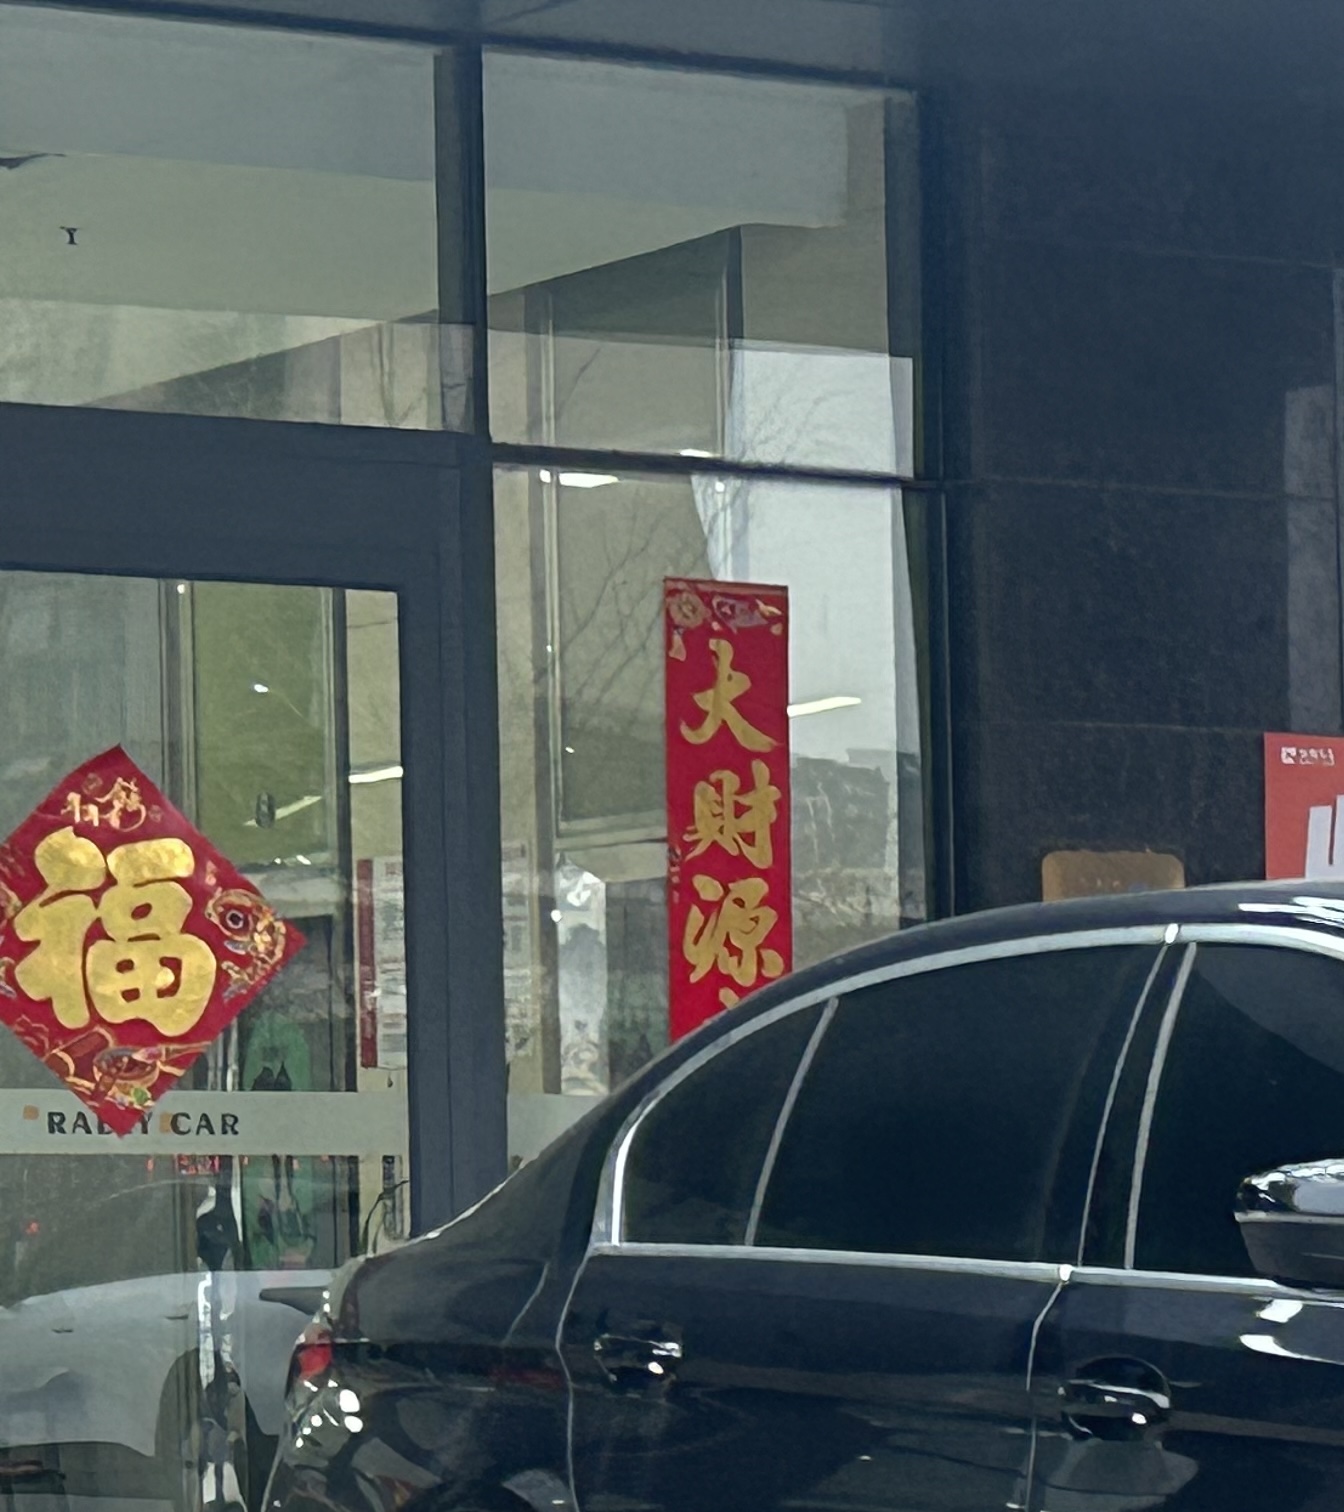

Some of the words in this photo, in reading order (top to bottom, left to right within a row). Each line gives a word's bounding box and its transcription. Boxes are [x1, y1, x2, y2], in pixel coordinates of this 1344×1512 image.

[13, 825, 217, 1037] 福
[47, 1111, 152, 1135] RALY
[170, 1112, 239, 1136] CAR
